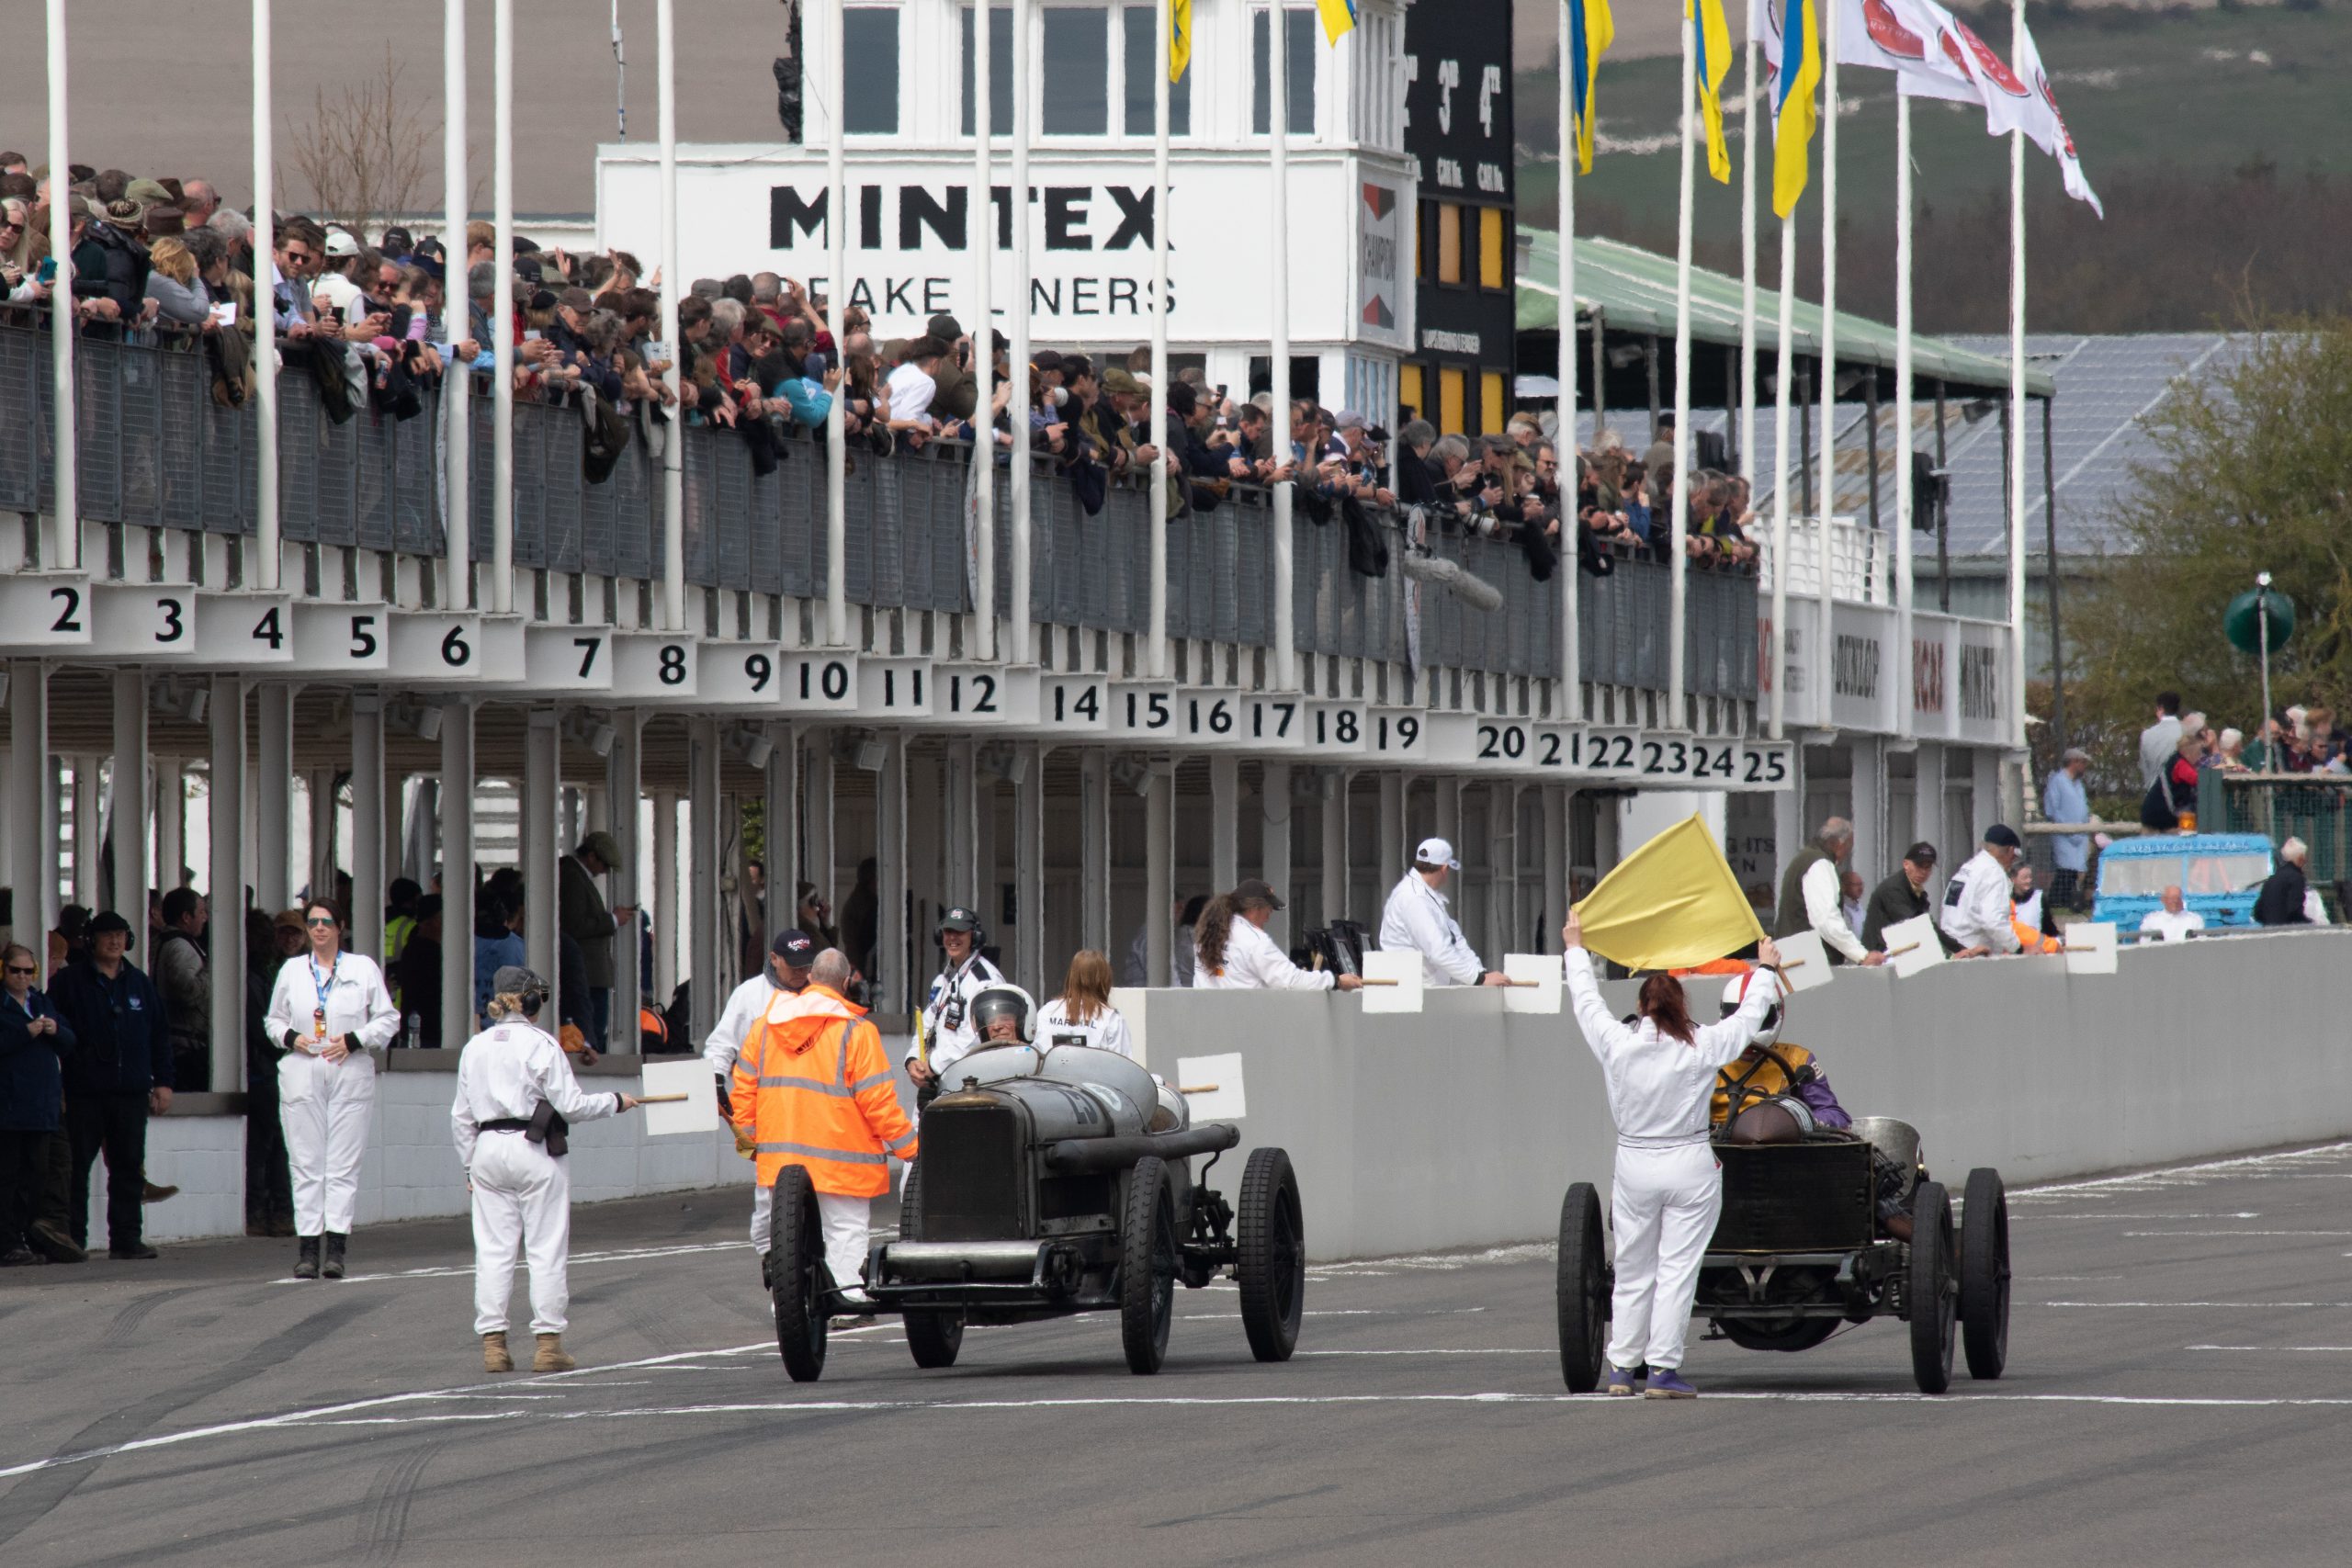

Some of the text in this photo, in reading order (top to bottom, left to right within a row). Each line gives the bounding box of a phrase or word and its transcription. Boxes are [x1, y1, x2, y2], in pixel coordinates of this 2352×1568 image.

[770, 185, 1176, 251] MINTEX
[1363, 233, 1396, 282] CHAMPION
[780, 277, 1176, 315] AKE NERS
[51, 587, 81, 632] 2
[155, 598, 183, 642] 3
[252, 606, 284, 649] 4
[350, 615, 377, 658] 5
[441, 625, 470, 667] 6
[573, 637, 602, 678] 7
[659, 645, 686, 685] 8
[744, 653, 772, 693] 9
[1912, 640, 1944, 712] UCAS
[800, 660, 848, 700] 10
[884, 669, 922, 706] 11
[950, 674, 996, 713] 12
[1055, 685, 1099, 722] 14
[1126, 692, 1170, 729] 15
[1189, 699, 1232, 734] 16
[1253, 703, 1295, 738] 17
[1317, 709, 1359, 744] 18
[1378, 716, 1419, 750] 19
[1477, 725, 1525, 759] 20
[1540, 732, 1579, 765] 21
[1589, 735, 1634, 768] 22
[1642, 741, 1687, 773] 23
[1692, 745, 1735, 777] 24
[1744, 751, 1785, 783] 25
